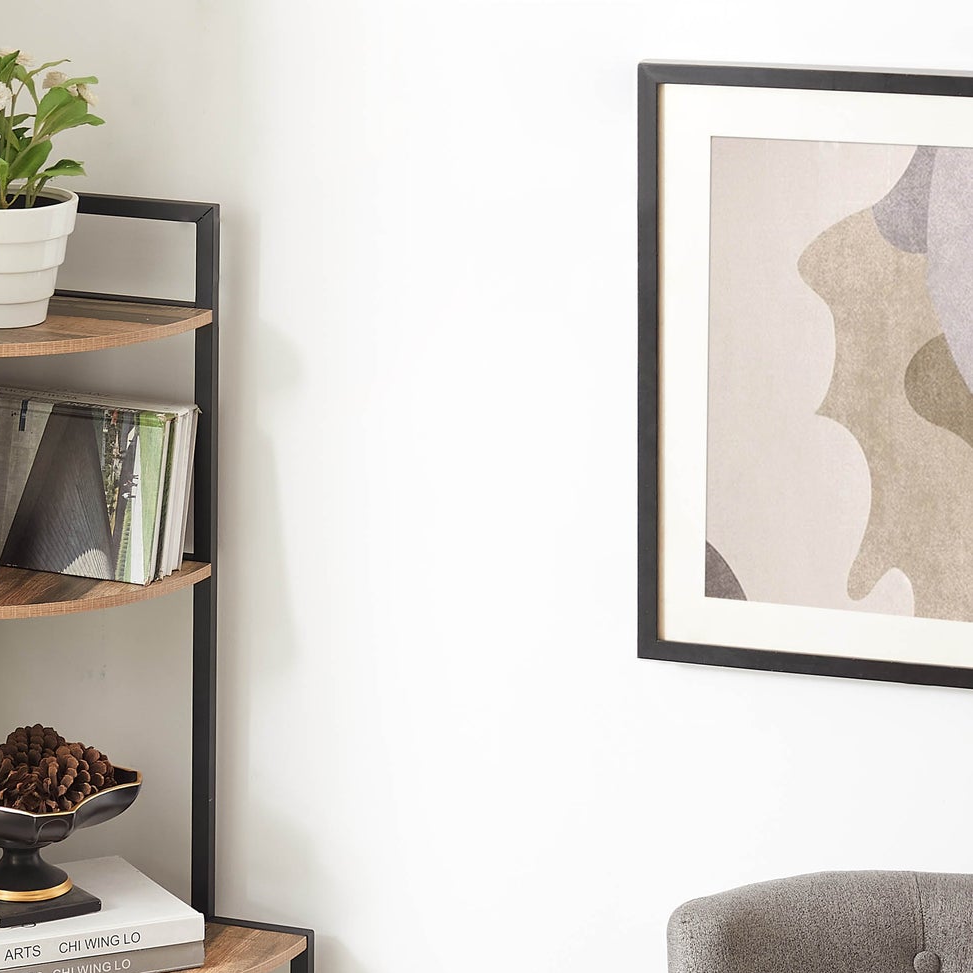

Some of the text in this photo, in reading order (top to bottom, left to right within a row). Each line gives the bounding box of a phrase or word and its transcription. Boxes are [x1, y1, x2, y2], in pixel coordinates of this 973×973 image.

[4, 931, 141, 962] ARTS CHI WING LO
[114, 958, 131, 971] LO
